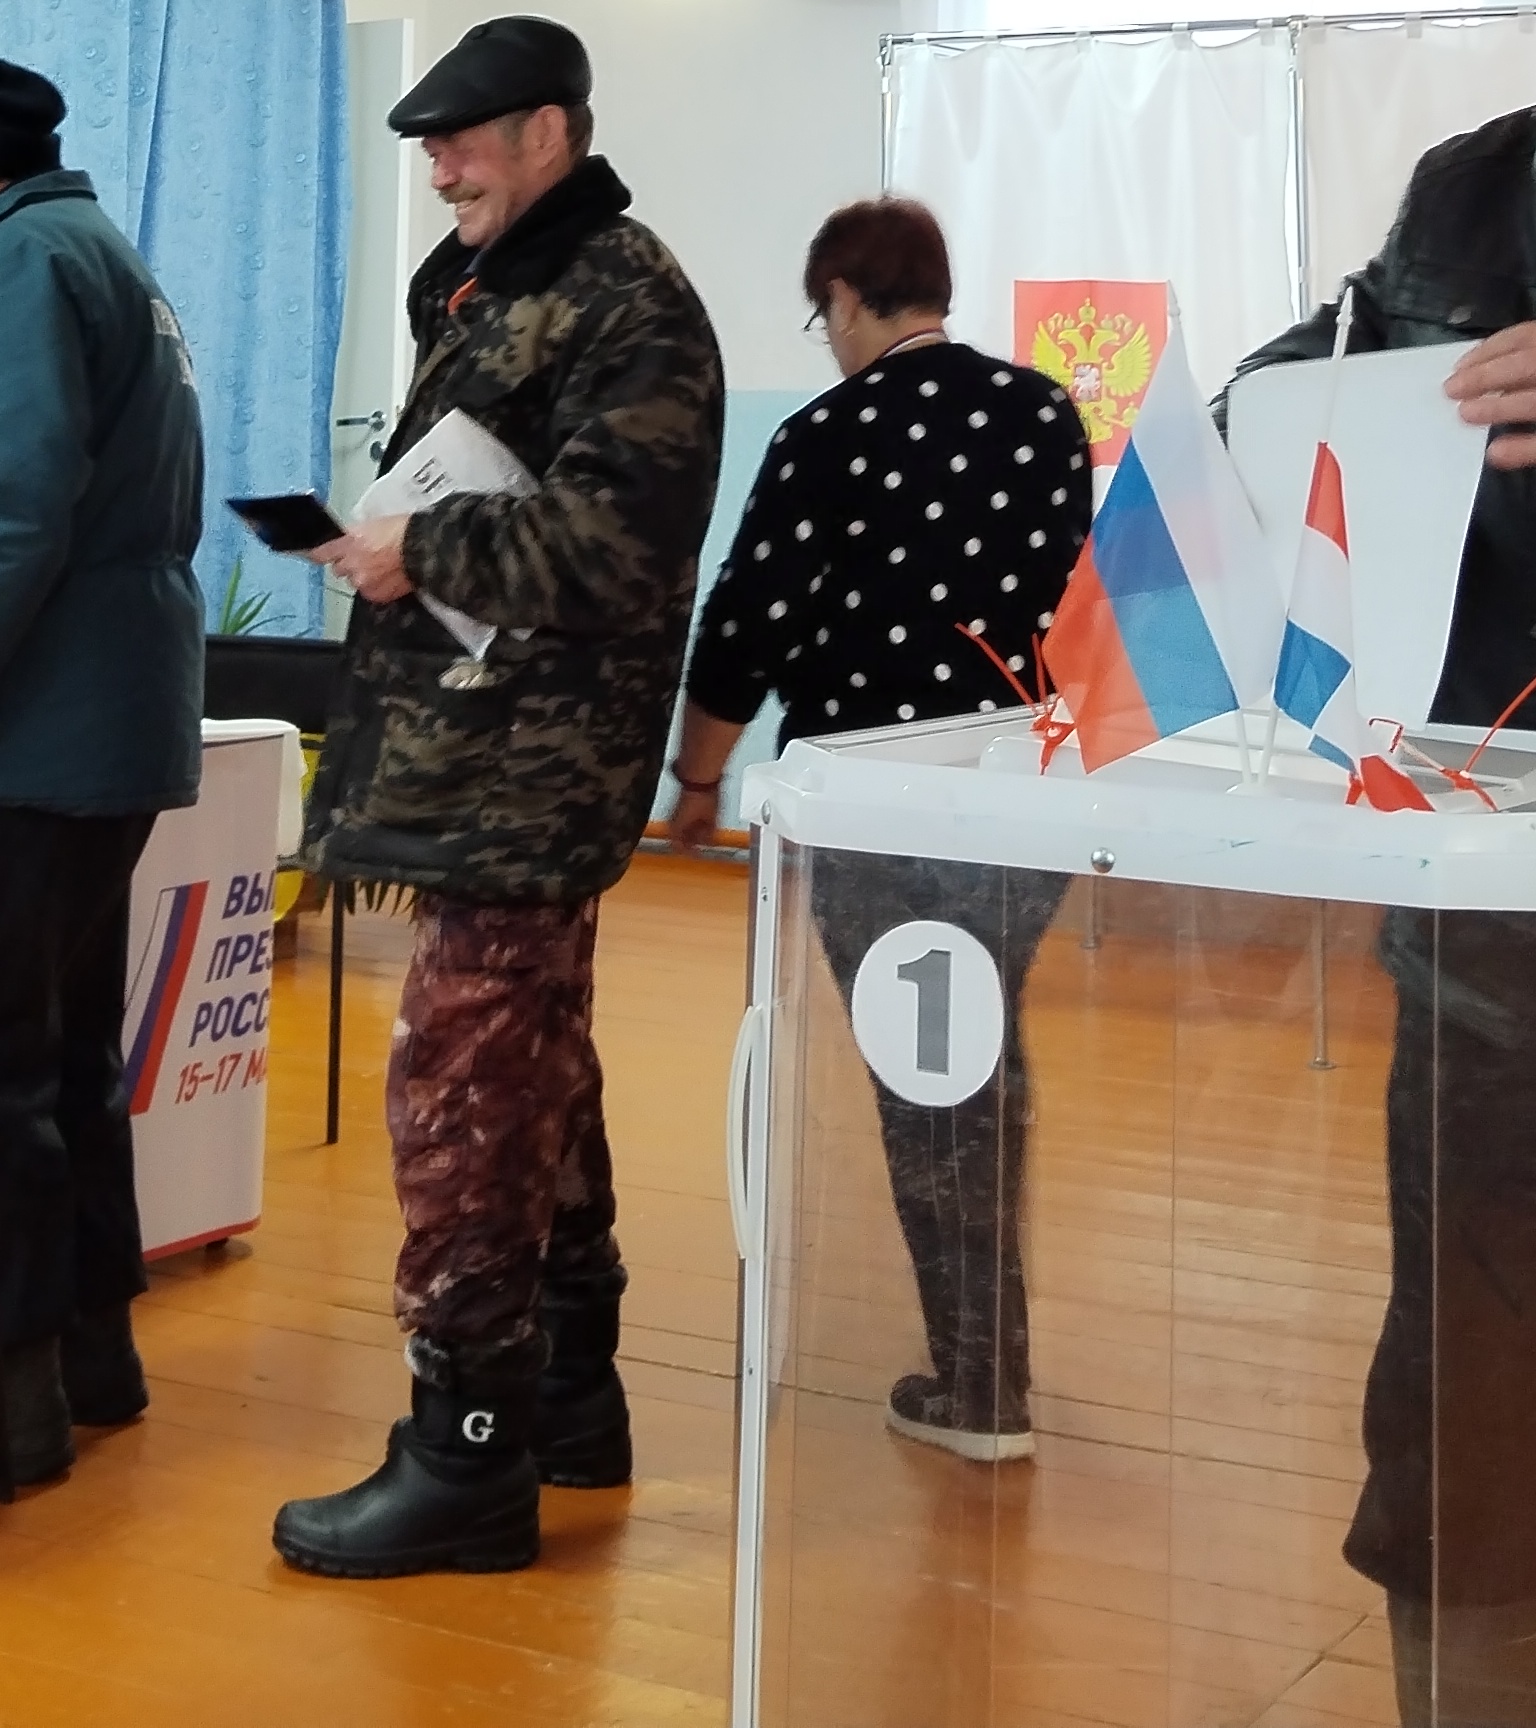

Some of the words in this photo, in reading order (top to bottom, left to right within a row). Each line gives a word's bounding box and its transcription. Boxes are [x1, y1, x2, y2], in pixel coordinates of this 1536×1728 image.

[222, 871, 274, 919] ВЫ
[205, 929, 272, 983] ПРЕ
[897, 948, 952, 1076] 1
[462, 1410, 495, 1443] G
